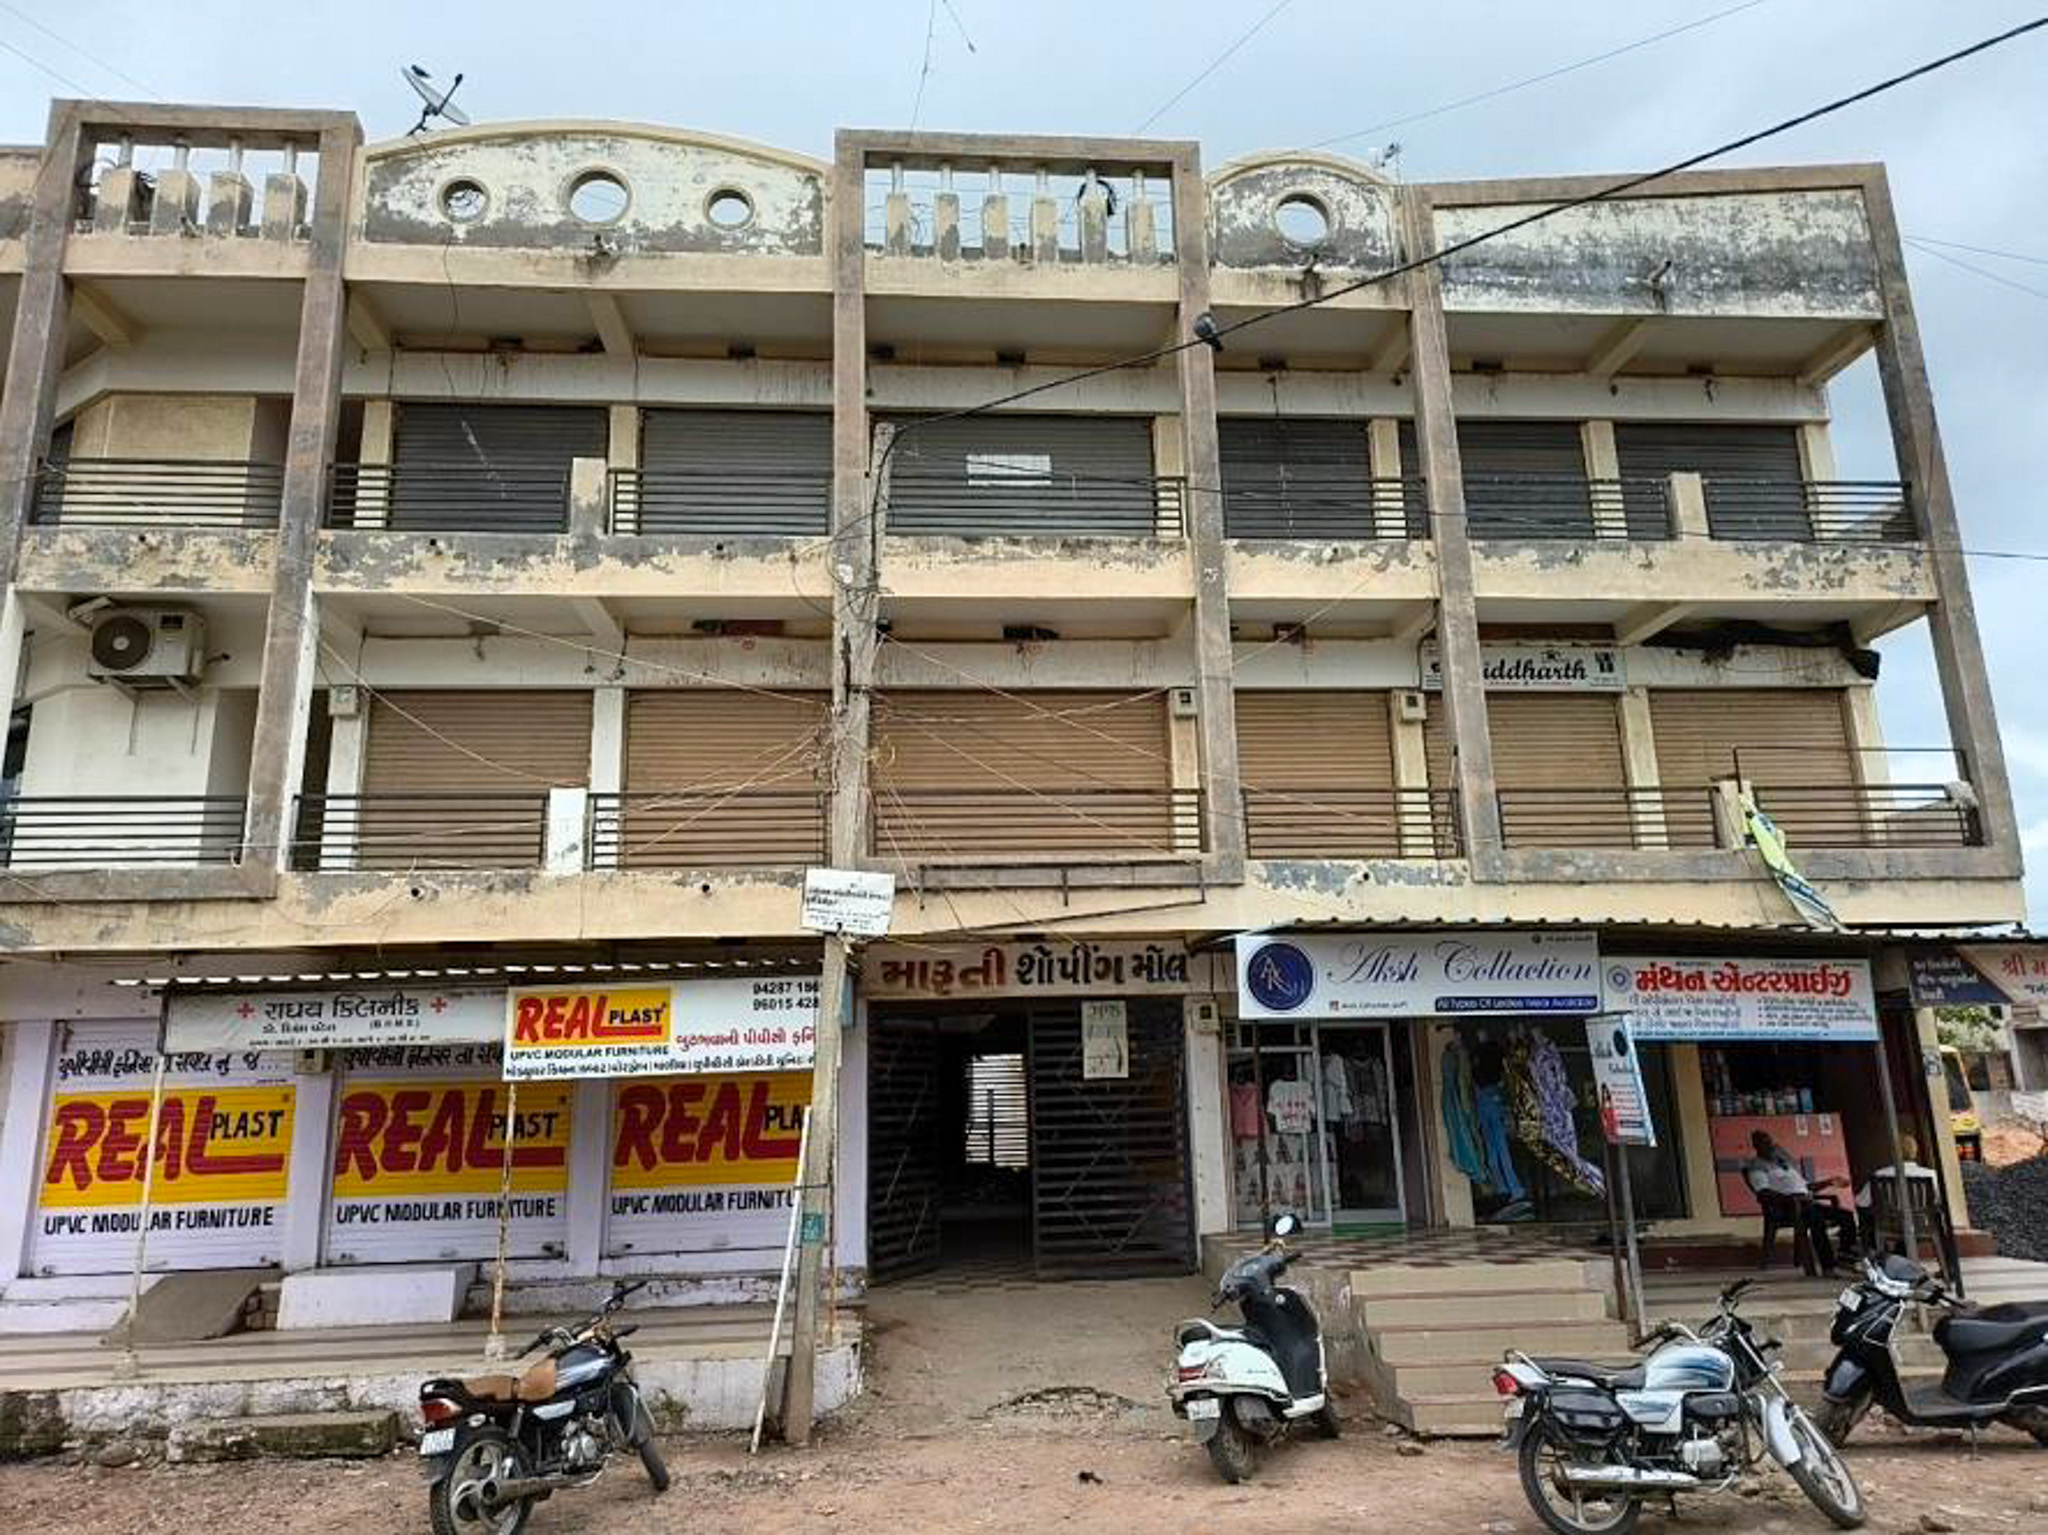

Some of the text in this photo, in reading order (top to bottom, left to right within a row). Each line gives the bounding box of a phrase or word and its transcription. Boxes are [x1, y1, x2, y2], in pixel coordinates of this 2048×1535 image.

[1484, 658, 1588, 681] iddharth
[1327, 941, 1420, 983] Aksh
[516, 995, 662, 1042] REAL PLAST
[510, 1050, 542, 1062] UPVC
[545, 1048, 602, 1060] MODULAR
[605, 1045, 669, 1057] FURNITURE
[47, 1096, 285, 1191] REAL PLAST
[334, 1088, 565, 1182] REAL
[614, 1081, 803, 1172] REAL PLA
[337, 1203, 380, 1224] UPVC
[385, 1201, 463, 1222] MODULAR
[611, 1189, 794, 1215] UPVC MODULAR FURNITU
[44, 1206, 274, 1235] UPVC MODUAR FURNITURE
